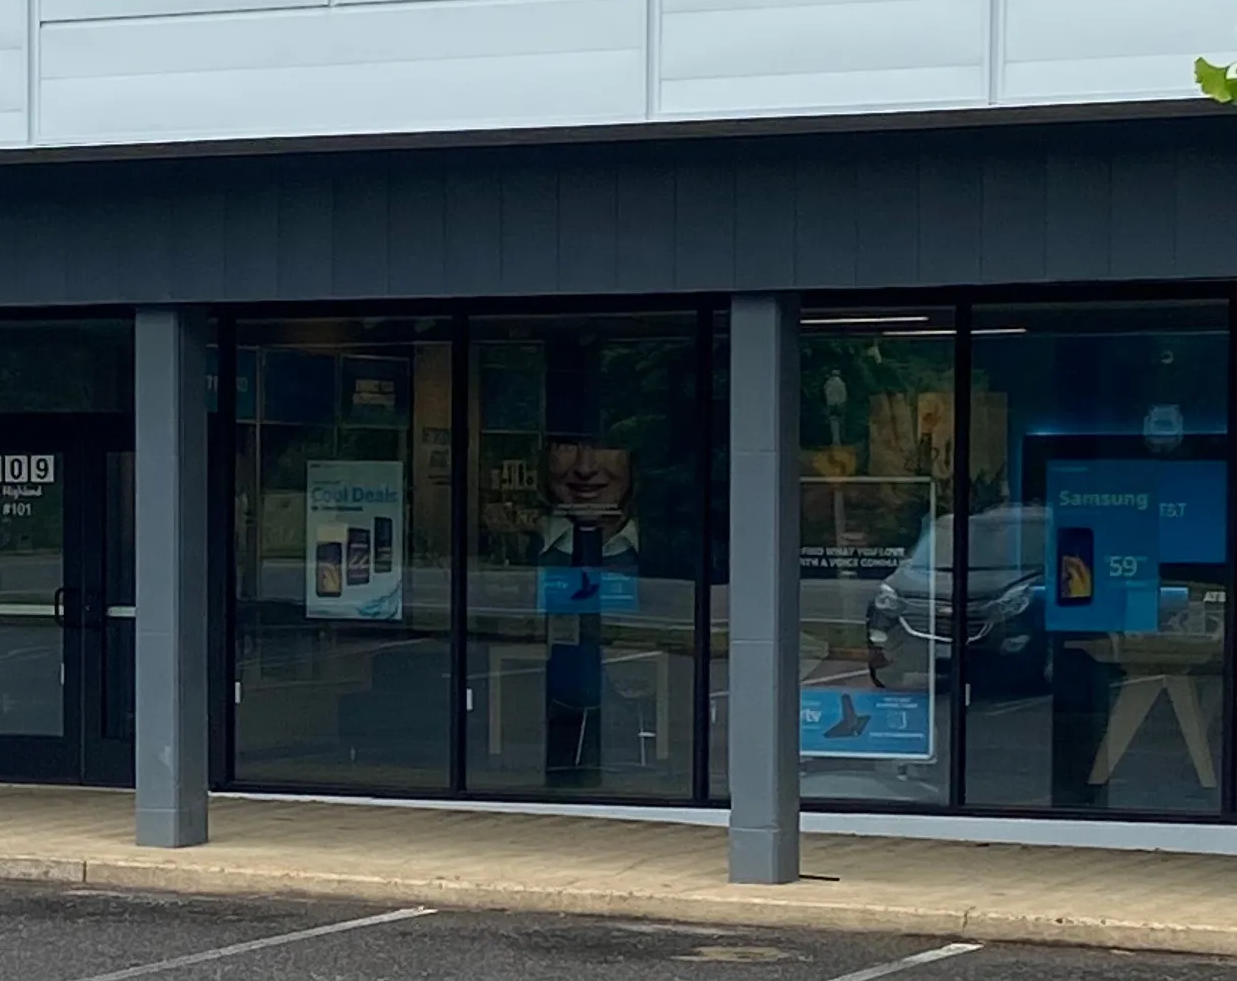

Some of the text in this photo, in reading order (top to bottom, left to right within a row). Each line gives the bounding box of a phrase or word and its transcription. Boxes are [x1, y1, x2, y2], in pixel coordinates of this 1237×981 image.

[352, 486, 399, 503] Deals
[1059, 490, 1149, 510] Samsung
[2, 503, 33, 516] #101
[1158, 502, 1187, 518] T&T
